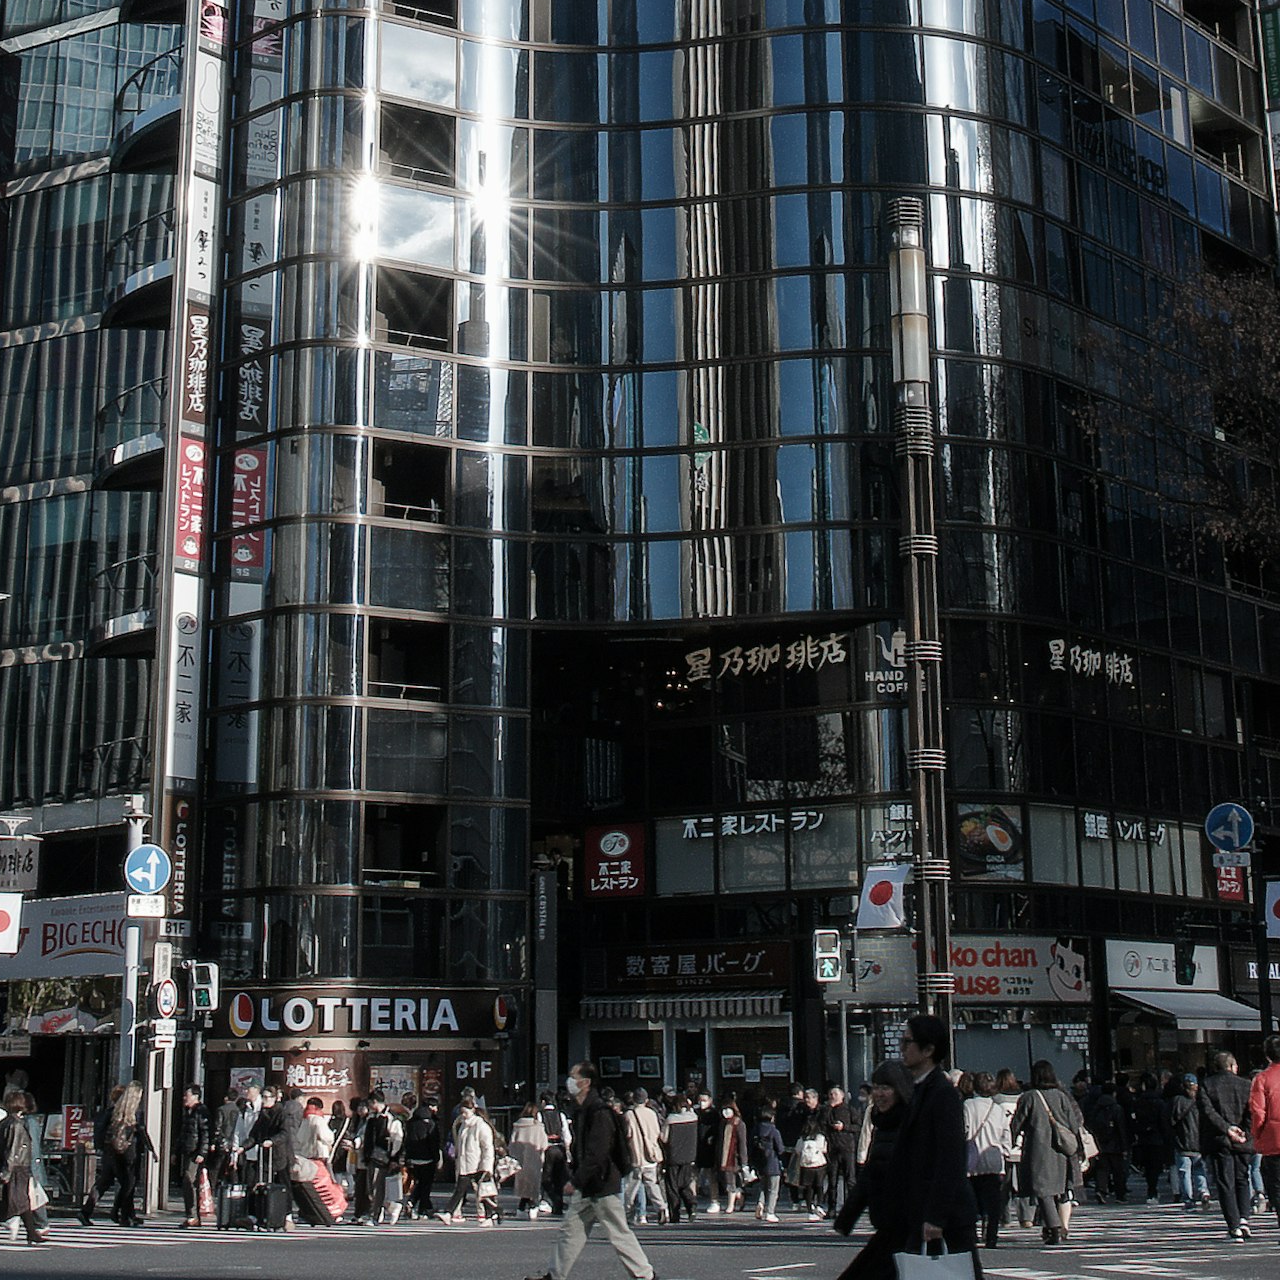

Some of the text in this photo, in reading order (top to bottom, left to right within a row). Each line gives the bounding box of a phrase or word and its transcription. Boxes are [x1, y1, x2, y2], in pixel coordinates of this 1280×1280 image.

[196, 111, 214, 126] Skin
[186, 314, 210, 413] 星乃珈琲店
[179, 463, 193, 532] レストラン
[189, 466, 205, 534] 不二家
[183, 559, 196, 569] 2F
[685, 632, 847, 683] 星乃珈琲店
[1049, 638, 1134, 686] 星乃珈琲店
[176, 644, 195, 724] 不二家
[865, 669, 905, 682] HAND
[682, 812, 824, 839] 不二家レストラン
[173, 821, 188, 916] LOTTERIA
[598, 860, 632, 876] 不二家
[590, 876, 640, 892] レストラン
[78, 903, 125, 915] Entertainmen
[42, 922, 78, 956] BIG
[165, 918, 185, 934] B1F
[624, 950, 766, 977] 数寄屋バーグ
[981, 941, 1038, 969] chan
[952, 974, 1001, 997] ouse
[261, 996, 460, 1032] LOTTERIA
[286, 1064, 328, 1087] 絶品
[456, 1060, 493, 1079] B1F
